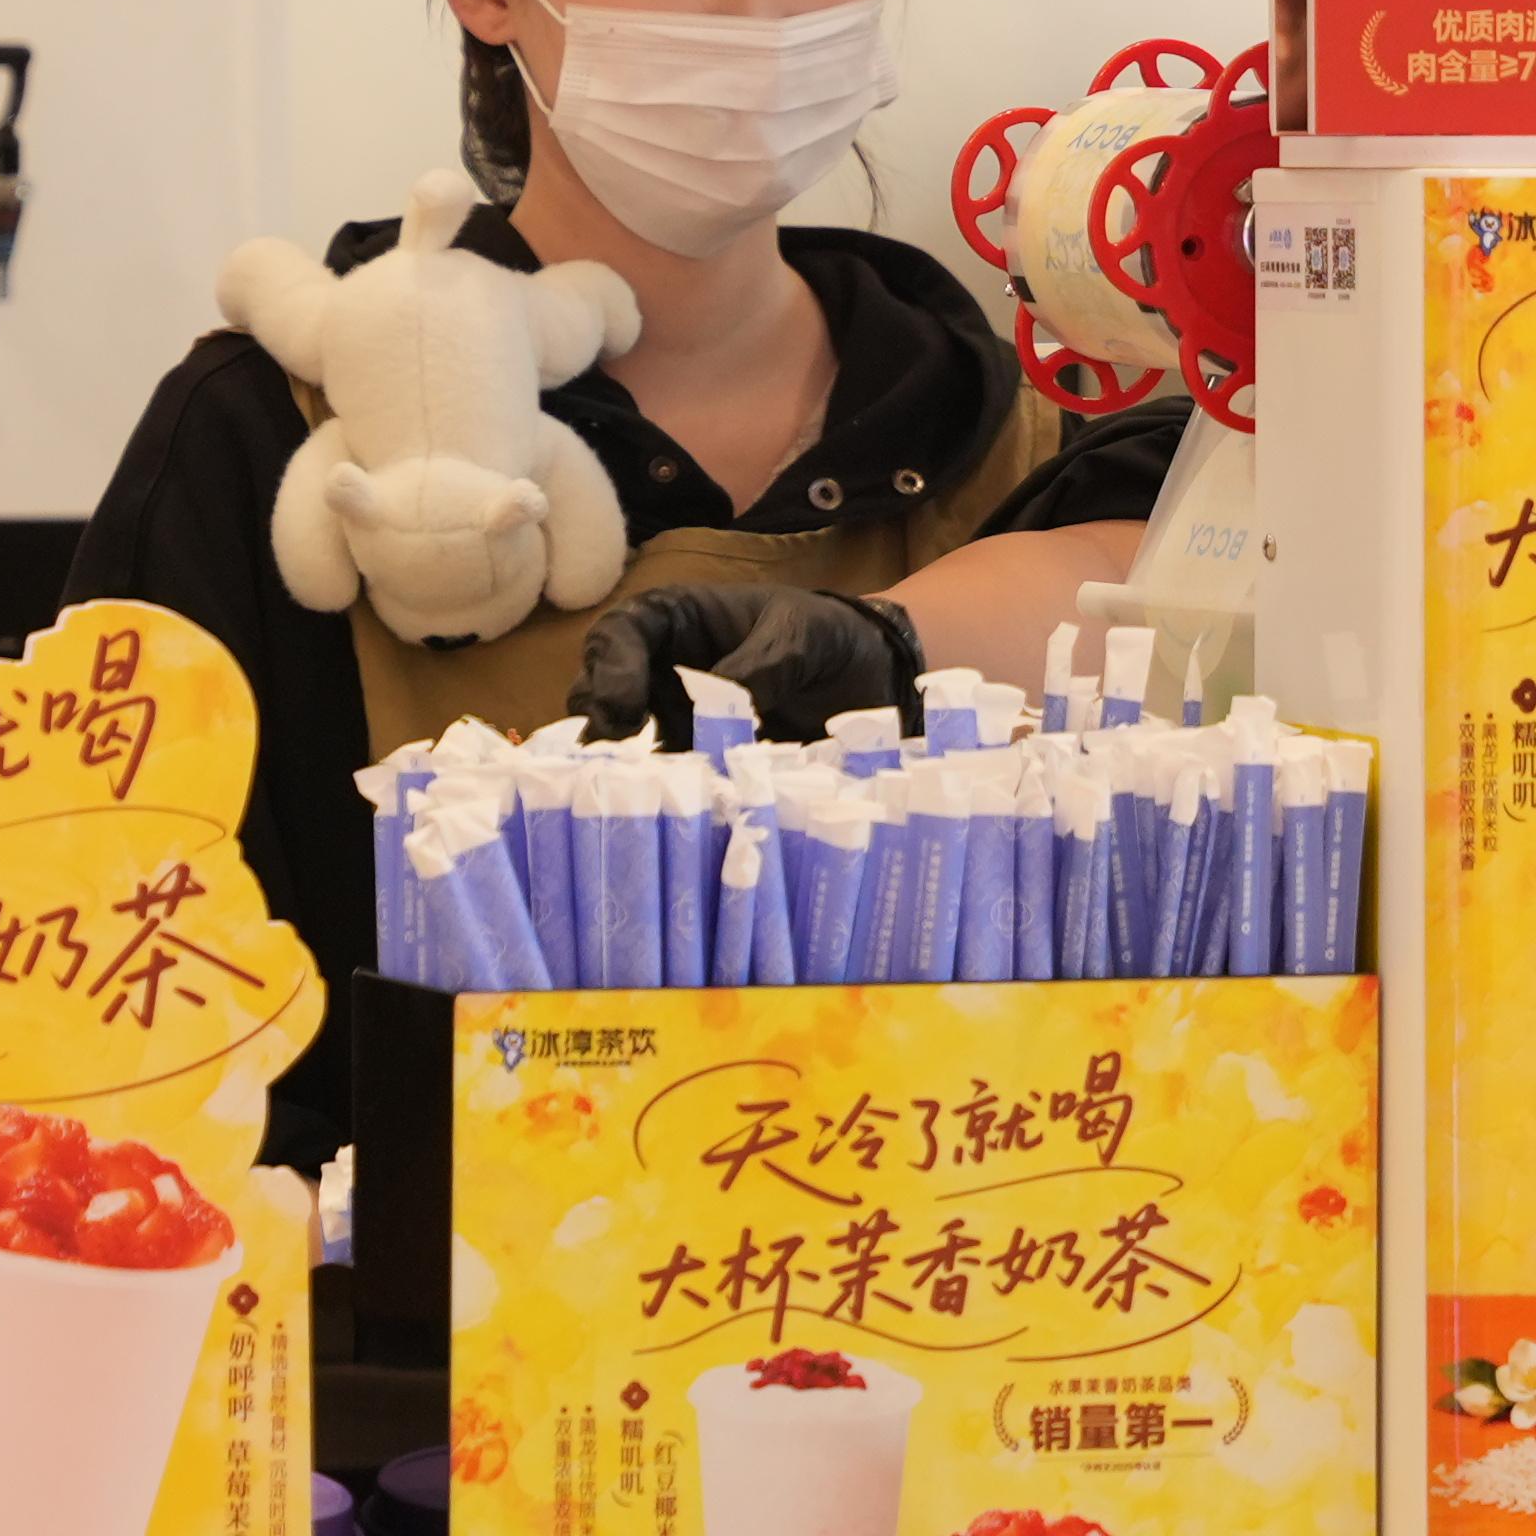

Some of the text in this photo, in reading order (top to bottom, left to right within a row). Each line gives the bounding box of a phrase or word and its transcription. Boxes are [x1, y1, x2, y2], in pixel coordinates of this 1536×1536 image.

[701, 1052, 1133, 1204] 天冷了就喝
[639, 1205, 1211, 1344] 大杯茉香奶茶
[227, 1333, 255, 1536] 奶呼呼 草莓茉
[1030, 1402, 1213, 1451] 销量第一
[1049, 1376, 1192, 1395] 水果茉香奶茶品类
[620, 1418, 644, 1495] 糯叽叽
